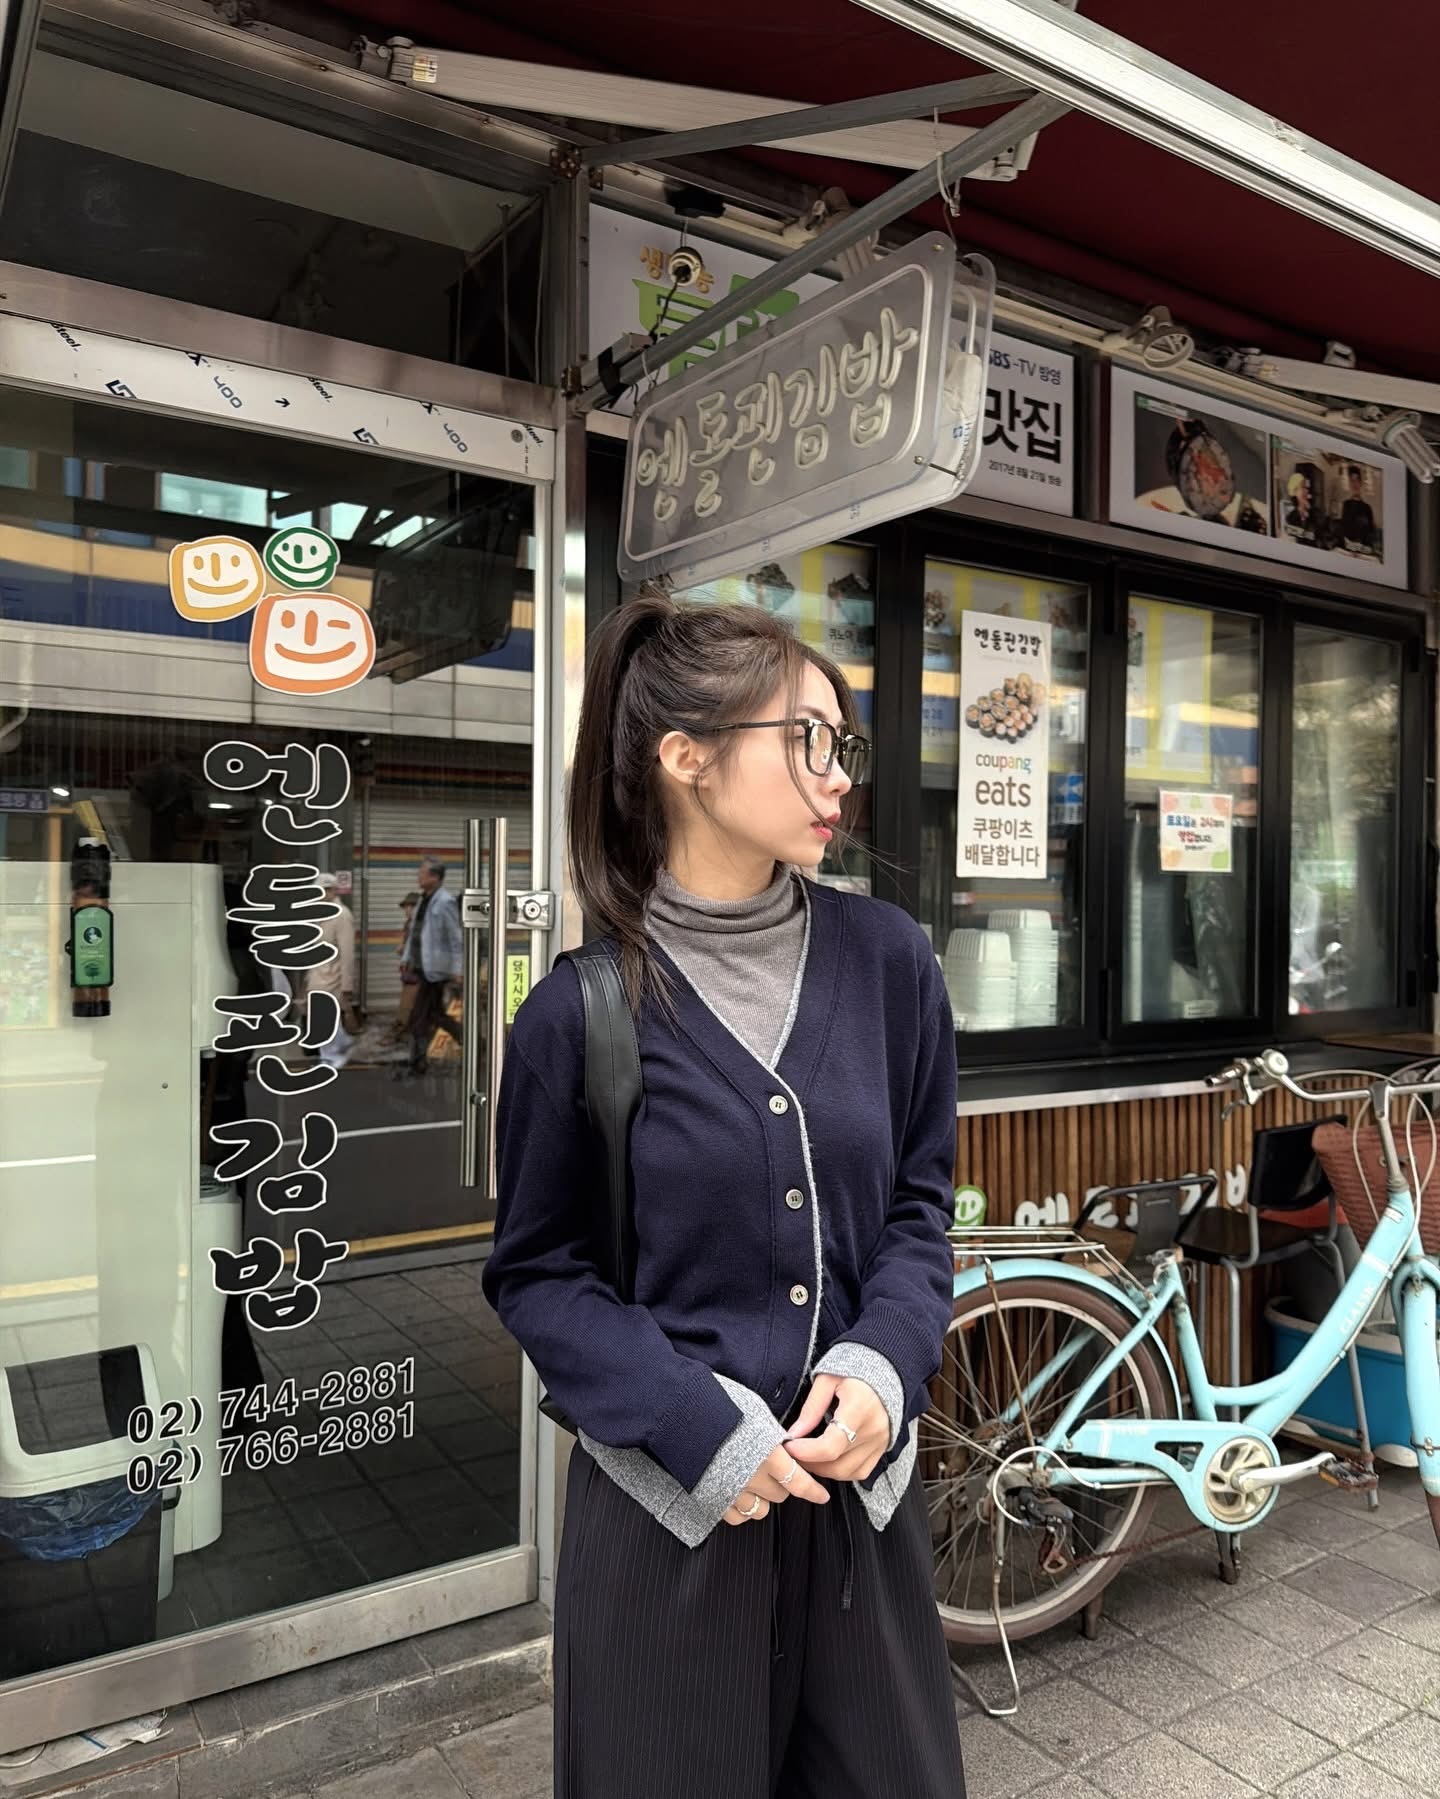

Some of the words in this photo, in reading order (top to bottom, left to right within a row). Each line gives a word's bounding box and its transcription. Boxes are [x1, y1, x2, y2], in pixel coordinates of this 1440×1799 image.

[213, 373, 243, 409] 400
[1039, 365, 1062, 386] 방영
[443, 422, 469, 454] 400
[982, 387, 1062, 464] 맛집
[975, 754, 1032, 774] coupang
[975, 776, 1032, 808] eats
[973, 817, 1034, 840] 쿠팡이츠
[964, 844, 1040, 867] 배달합니다
[127, 1396, 204, 1445] 02)
[217, 1356, 415, 1430] 744-2881
[126, 1445, 204, 1494] 02)
[216, 1400, 415, 1477] 766-2881
